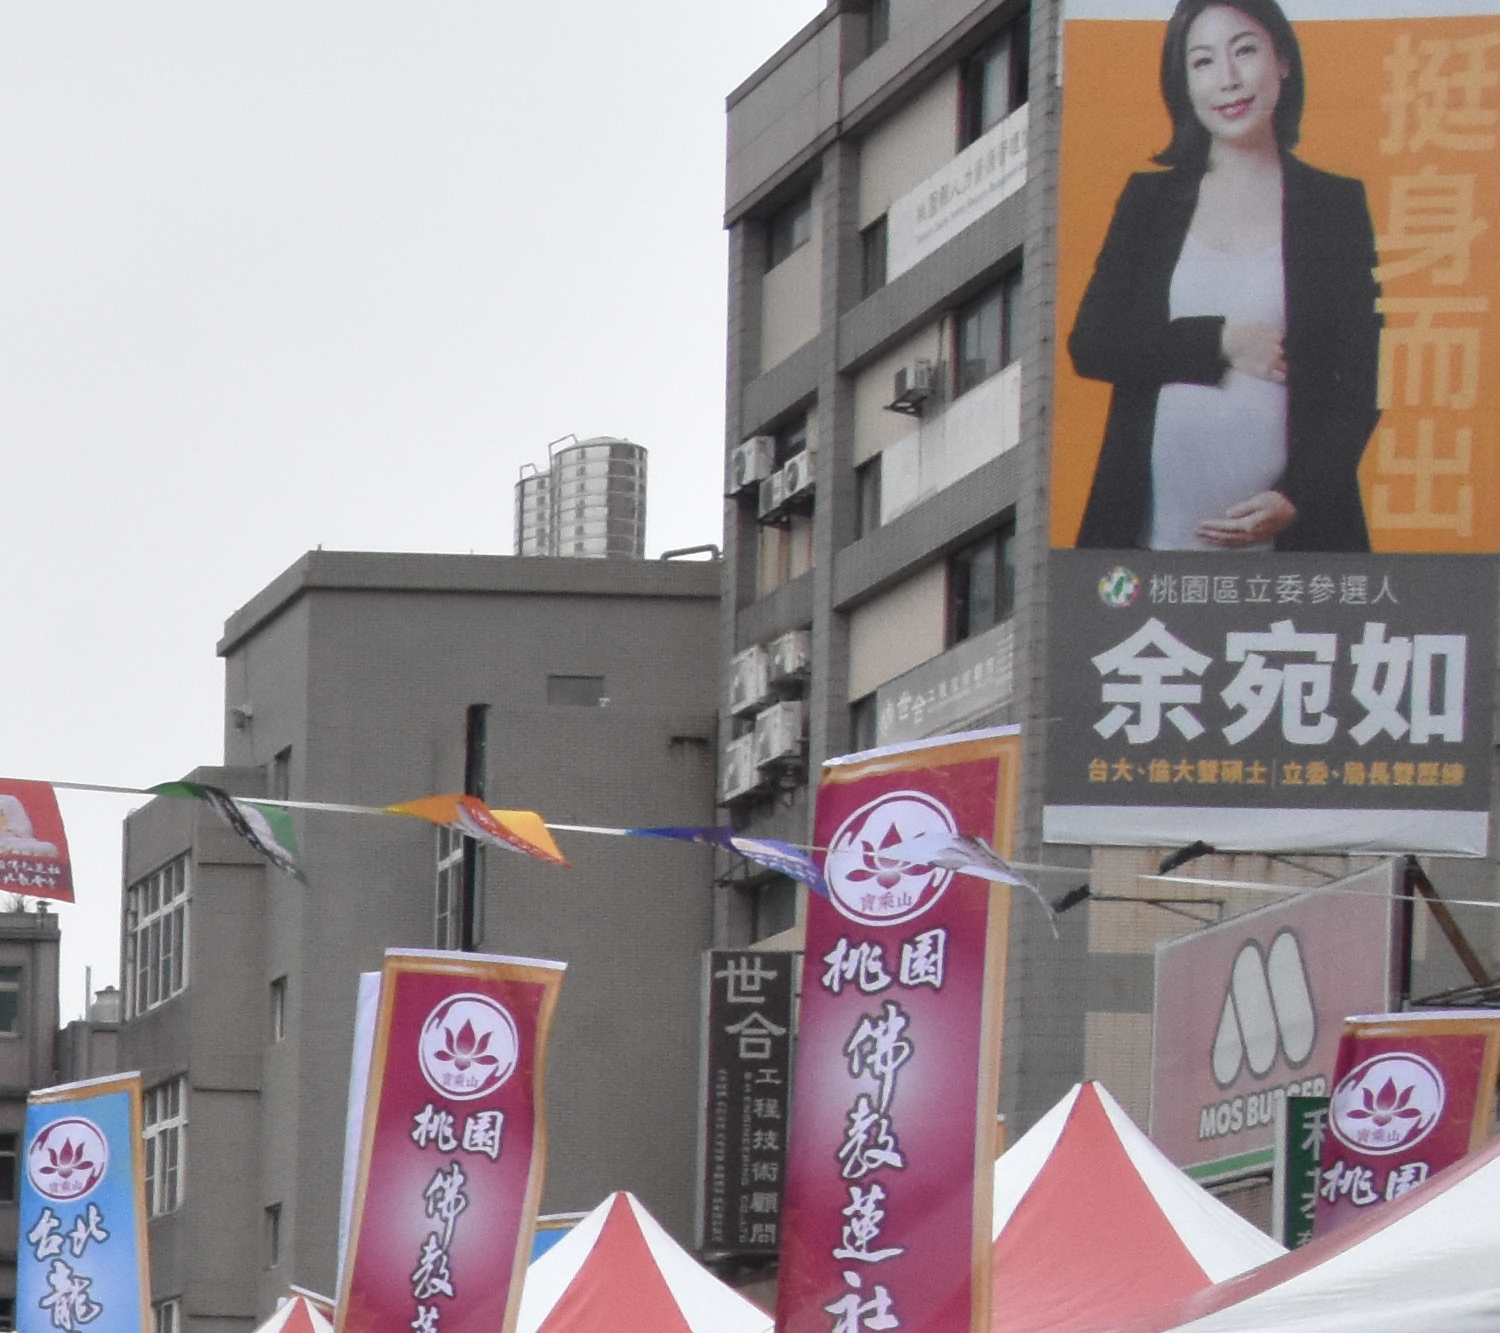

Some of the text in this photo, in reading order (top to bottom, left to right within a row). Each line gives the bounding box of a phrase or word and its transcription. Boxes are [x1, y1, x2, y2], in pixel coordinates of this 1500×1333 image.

[1373, 32, 1500, 538] 挺身而出
[1149, 573, 1399, 606] 桃園區立委參選人
[1091, 617, 1467, 747] 余宛如
[822, 928, 948, 992] 桃園
[715, 956, 786, 1058] 世合
[411, 1104, 504, 1158] 桃園
[1199, 1097, 1245, 1140] MOS
[750, 1068, 781, 1244] 工程技術顧問
[27, 1205, 111, 1261] 台北
